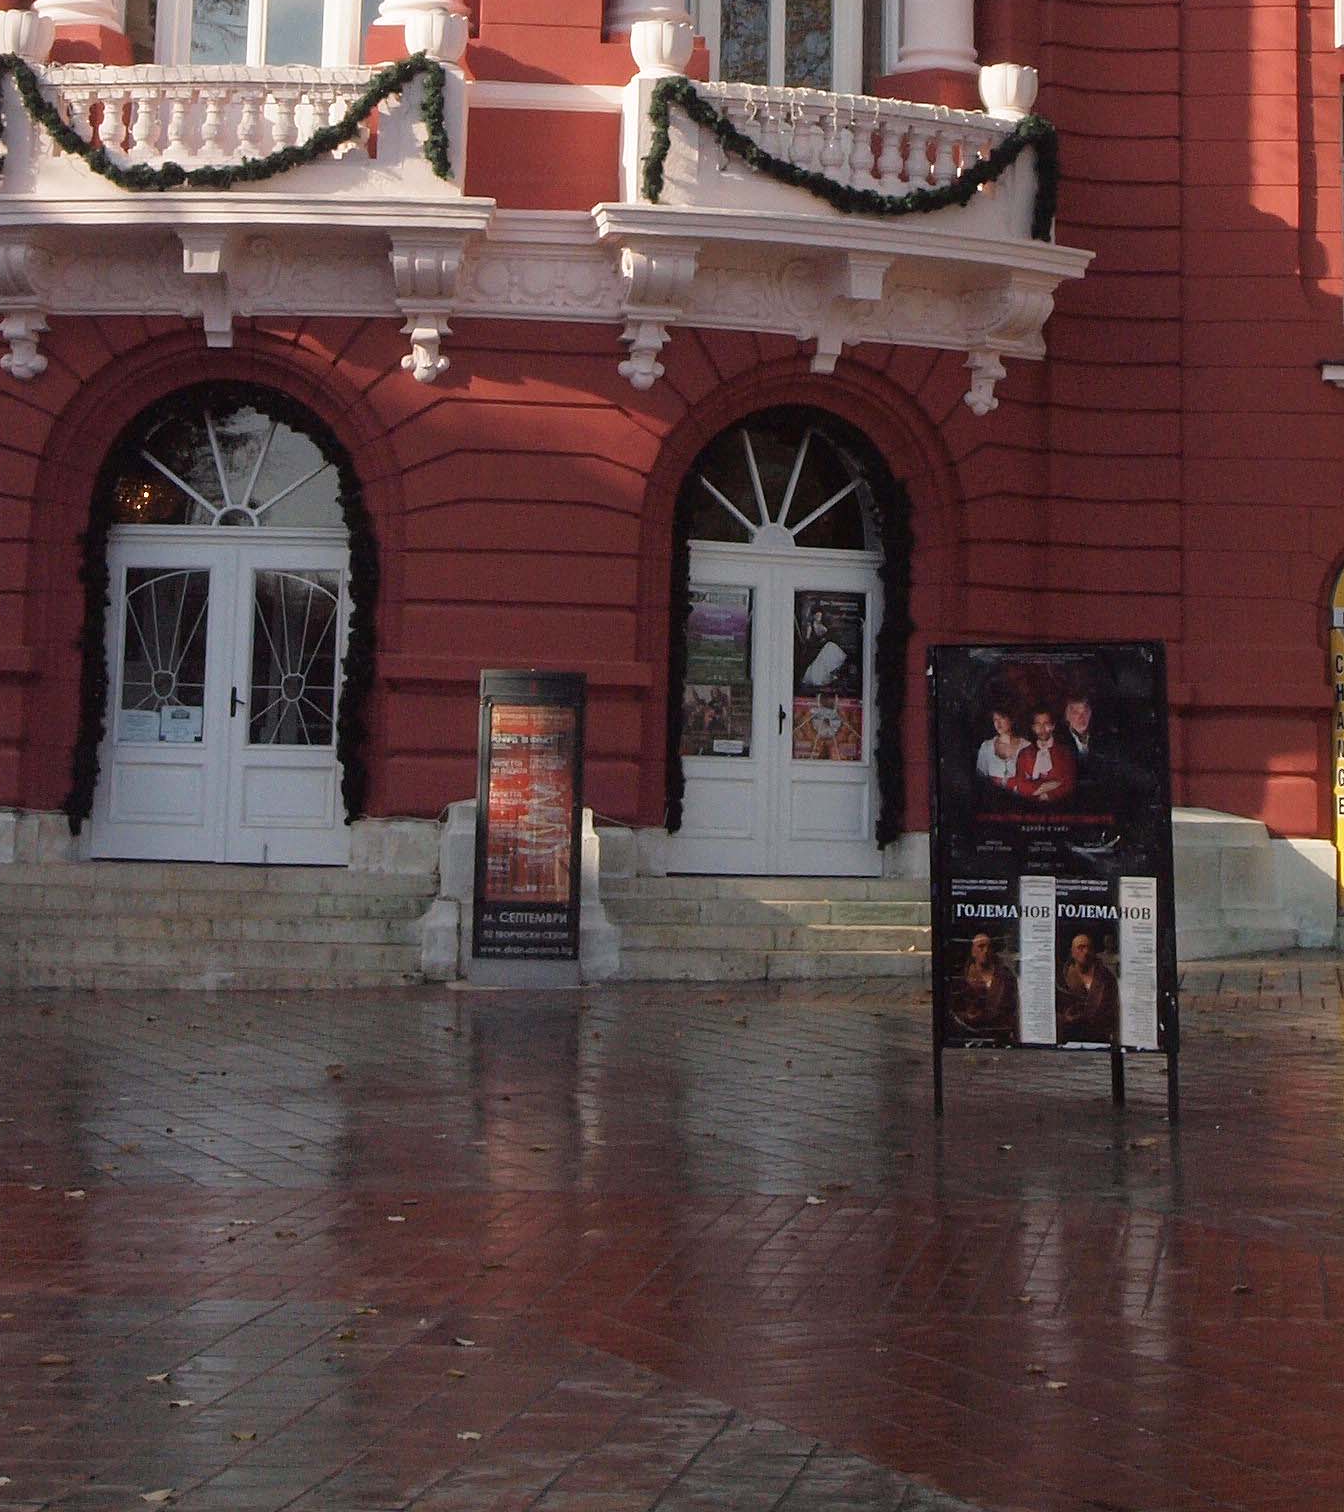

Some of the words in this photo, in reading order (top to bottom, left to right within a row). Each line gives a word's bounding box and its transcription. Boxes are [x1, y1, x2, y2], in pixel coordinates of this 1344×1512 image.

[498, 911, 568, 923] СЕПТЕМВРИ
[956, 903, 1052, 919] ГОЛЕМАНОВ
[1056, 903, 1152, 921] ГОЛЕМАНОВ
